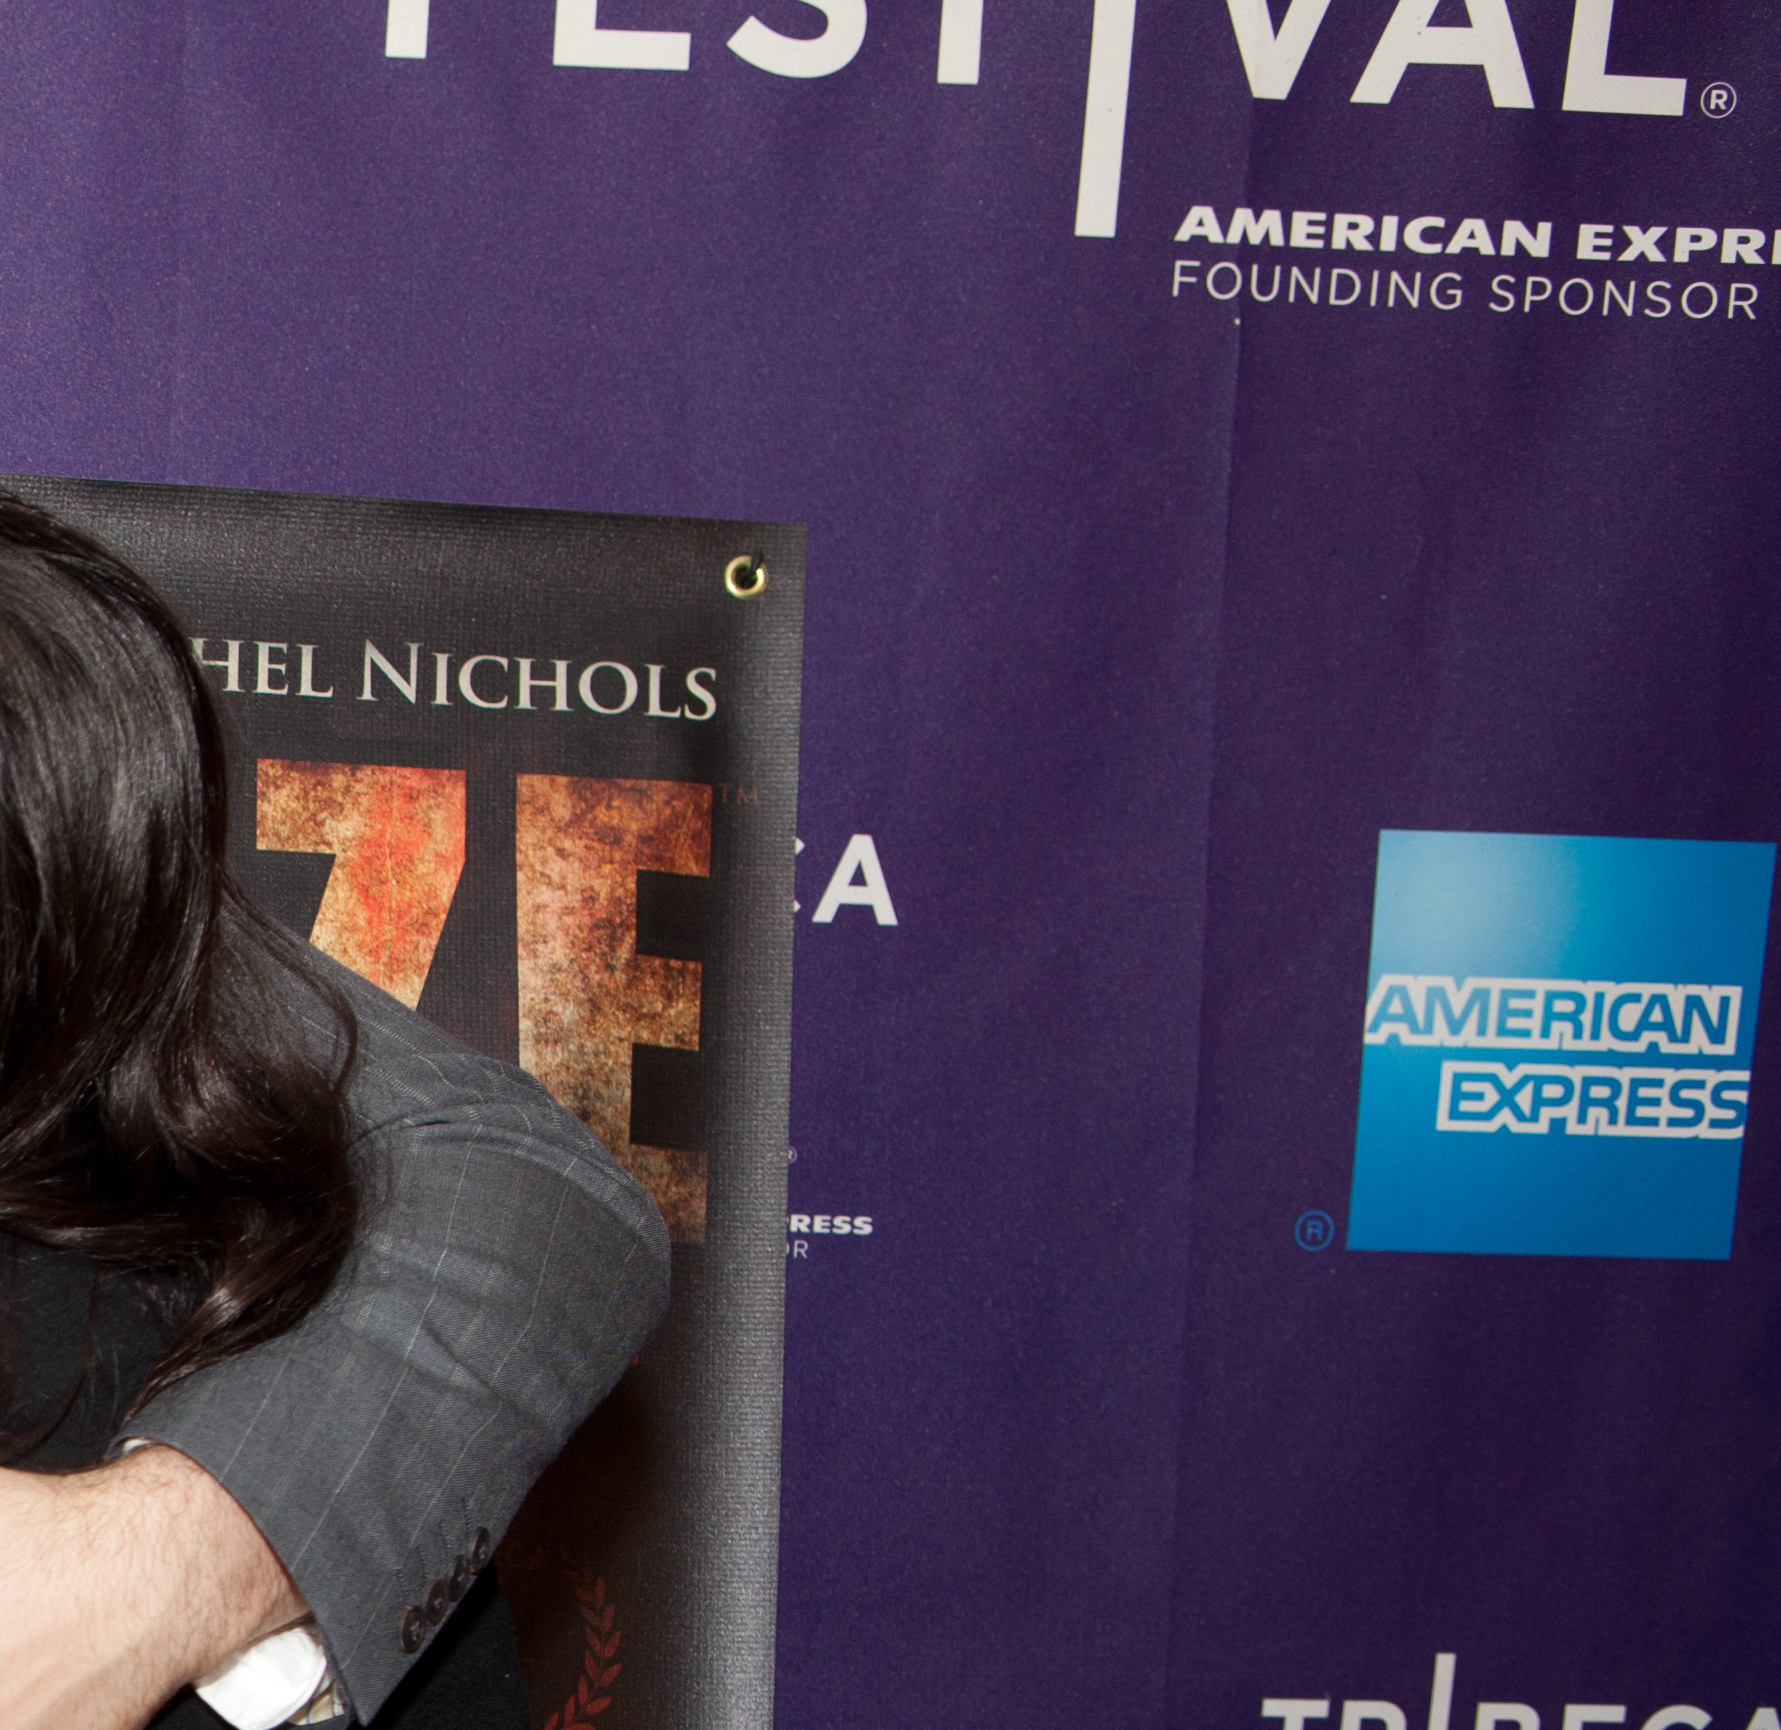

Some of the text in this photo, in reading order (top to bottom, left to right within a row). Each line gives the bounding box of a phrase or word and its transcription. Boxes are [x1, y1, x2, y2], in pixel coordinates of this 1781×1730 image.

[1175, 206, 1781, 264] AMERICAN EXPR
[1173, 260, 1757, 319] FOUNDING SPONSOR
[190, 637, 717, 721] HEL NICHOLS
[256, 759, 713, 1243] ZE
[1363, 974, 1742, 1055] AMERICAN
[1436, 1061, 1750, 1139] EXPRESS
[788, 1213, 874, 1236] RESS
